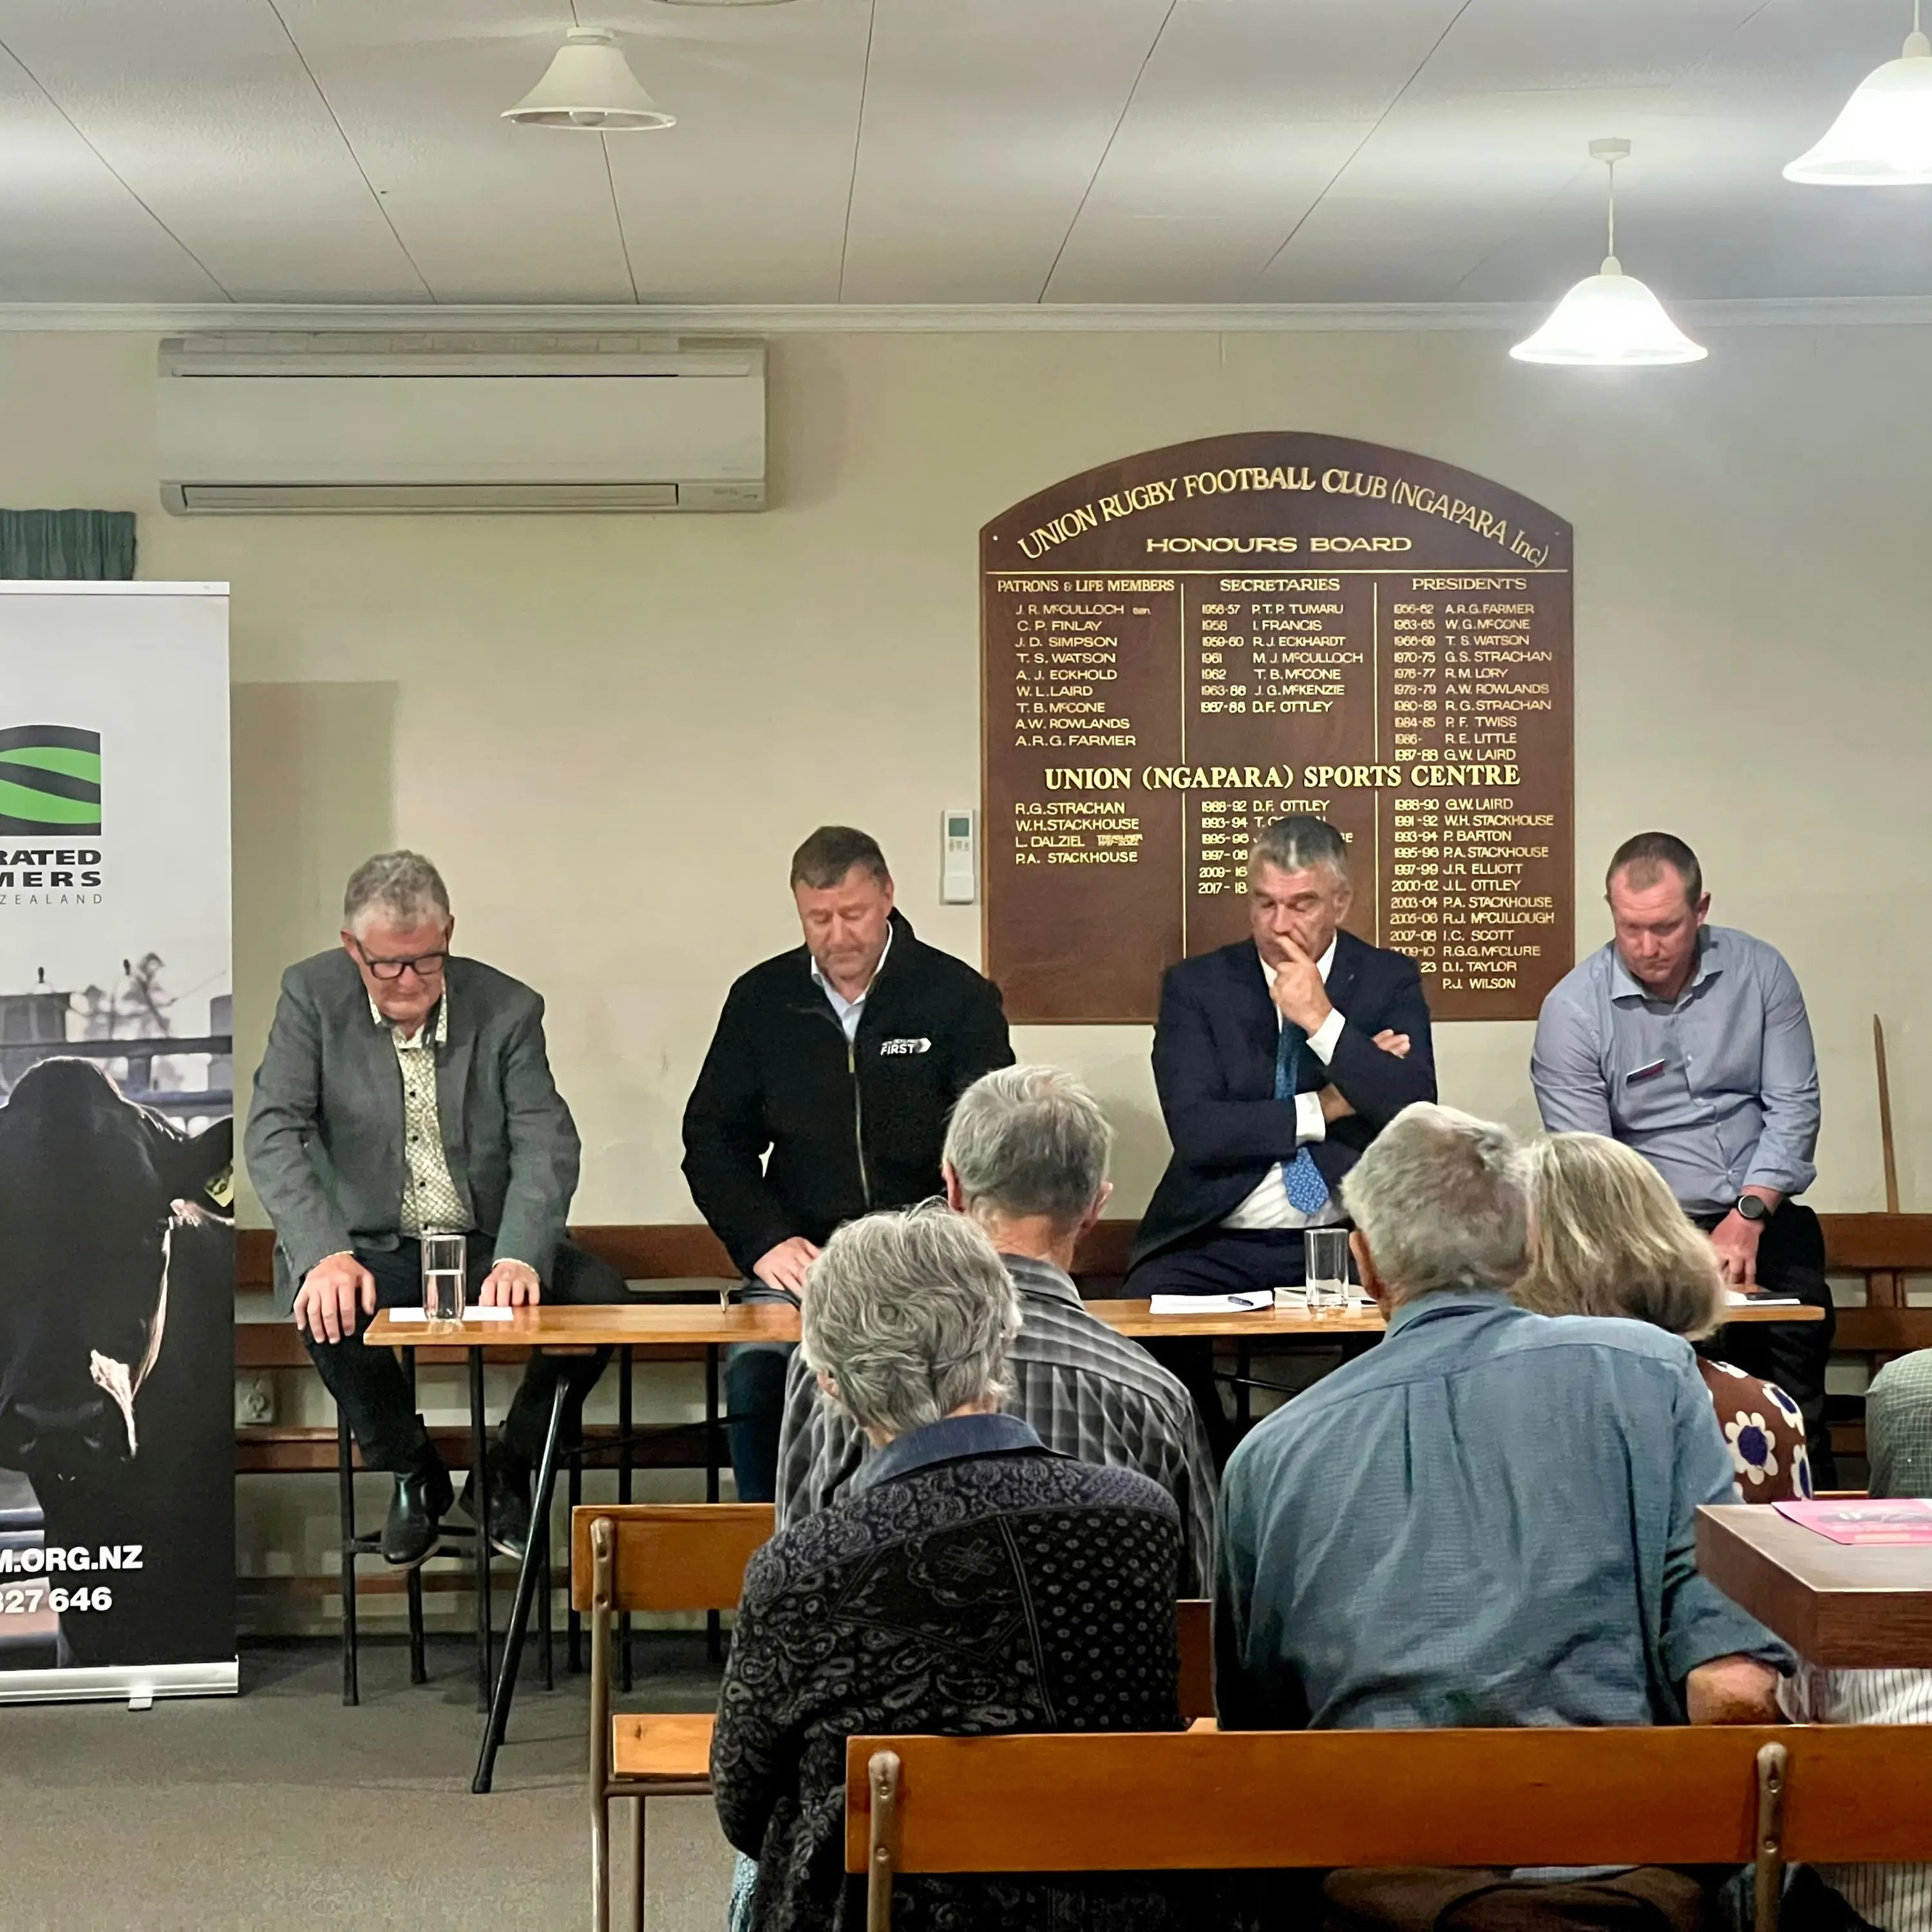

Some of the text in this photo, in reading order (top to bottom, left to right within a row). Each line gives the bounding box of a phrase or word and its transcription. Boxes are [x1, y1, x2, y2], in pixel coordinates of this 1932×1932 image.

[1018, 504, 1097, 559] UNION
[1099, 478, 1177, 522] RUGBY
[1183, 467, 1316, 498] FOOTBALL
[1321, 468, 1388, 499] CLUB
[1391, 478, 1508, 545] (NGAPARA
[1146, 537, 1412, 553] HONOURS BOARD
[998, 580, 1175, 592] PATRONS & LIFE MEMBERS
[1220, 578, 1340, 592] SECRETARIES
[1412, 578, 1526, 590] PRESIDENTS
[1289, 604, 1343, 614] TUMARU
[1394, 604, 1434, 614] 1956-62
[1483, 604, 1534, 614] FARMER
[1052, 621, 1102, 631] FINLAY
[1202, 620, 1322, 631] 1958 FRANCIS
[1394, 619, 1435, 630] 1963-65
[1048, 637, 1117, 647] SIMPSON
[1202, 636, 1244, 647] 1959-60
[1279, 636, 1346, 647] ECKHARDT
[1473, 635, 1529, 645] WATSON
[1052, 652, 1115, 663] WATSON
[1202, 652, 1222, 663] 1961
[1282, 652, 1363, 663] McCULLOCH
[1394, 652, 1435, 663] 1970-75
[1474, 651, 1552, 662] STRACHAN
[1050, 670, 1117, 680] ECKHOLD
[1202, 668, 1226, 679] 1962
[1394, 668, 1436, 679] 1976-77
[1475, 668, 1508, 678] LORY
[1394, 684, 1436, 695] 1978-79
[1476, 684, 1549, 694] ROWLANDS
[1280, 701, 1333, 712] OTTLEY
[1394, 700, 1437, 712] 1980-83
[1050, 719, 1130, 729] ROWLANDS
[1395, 717, 1435, 728] 1984-85
[1474, 716, 1517, 727] TWISS
[1069, 735, 1136, 746] FARMER
[1475, 733, 1517, 744] LITTLE
[1395, 749, 1438, 761] 1987-88
[1477, 749, 1516, 761] LAIRD
[1045, 764, 1520, 790] UNION (NGAPARA) SPORTS CENTRE
[1202, 800, 1247, 813] 1988-92
[1280, 800, 1330, 812] OTTLEY
[1395, 799, 1439, 811] 1988-90
[1476, 798, 1513, 810] LAIRD
[1202, 817, 1248, 828] 1993-94
[1473, 815, 1554, 826] STACKHOUSE
[1031, 835, 1085, 847] DALZIEL
[1395, 831, 1438, 842] 1993-94
[1457, 830, 1511, 842] BARTON
[1048, 851, 1138, 863] STACKHOUSE
[1466, 847, 1548, 858] STACKHOUSE
[1395, 864, 1438, 875] 1997-99
[1472, 864, 1523, 875] ELLIOTT
[1392, 880, 1439, 892] 2000-02
[1471, 880, 1521, 891] OTTLEY
[0, 894, 102, 904] ZEALAND
[1391, 896, 1437, 909] 2003-04
[1468, 896, 1553, 908] STACKHOUSE
[1471, 912, 1554, 923] McCULLOUGH
[1471, 930, 1515, 942] SCOTT
[1390, 946, 1435, 957] 009-10
[1466, 961, 1517, 972] TAYLOR
[1469, 978, 1515, 989] WILSON
[880, 1043, 914, 1056] FIRST
[0, 1587, 112, 1613] 27 646
